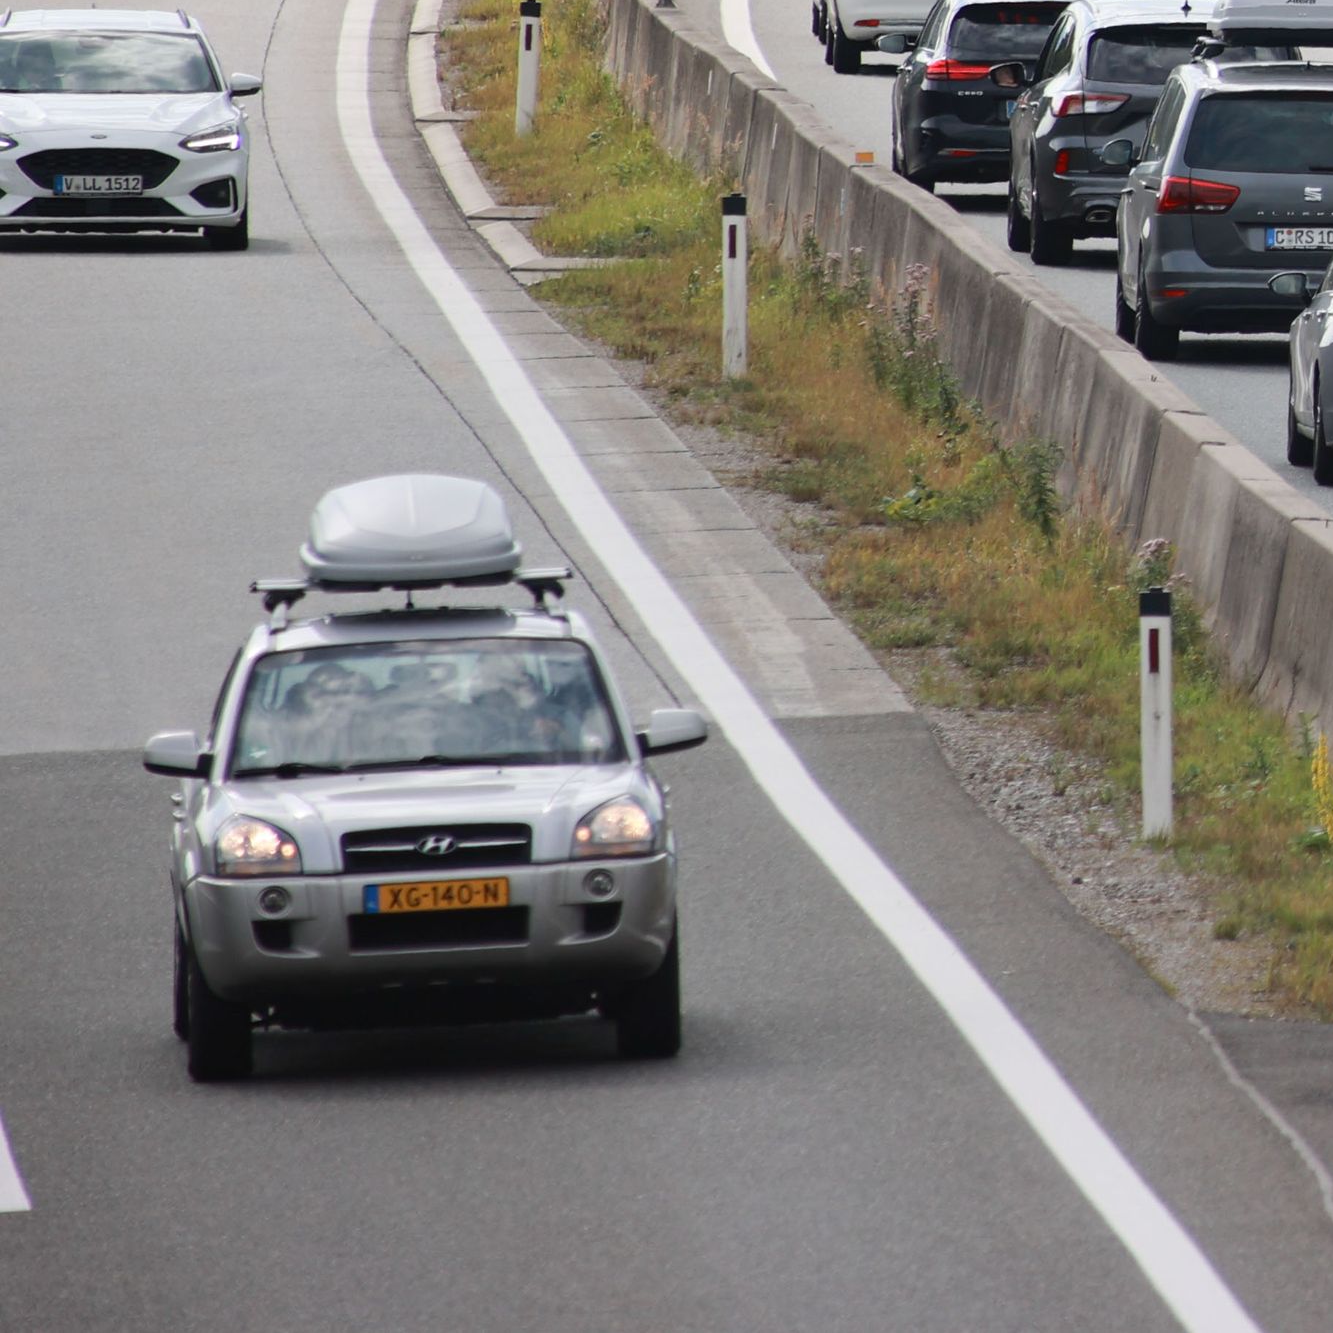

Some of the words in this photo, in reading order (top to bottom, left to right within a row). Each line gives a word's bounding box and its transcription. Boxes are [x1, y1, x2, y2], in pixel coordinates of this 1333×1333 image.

[65, 178, 73, 191] V
[83, 178, 102, 191] LL
[105, 177, 140, 191] 1512
[1275, 230, 1284, 244] C
[1295, 230, 1314, 244] RS
[389, 882, 499, 909] XG-140-N
